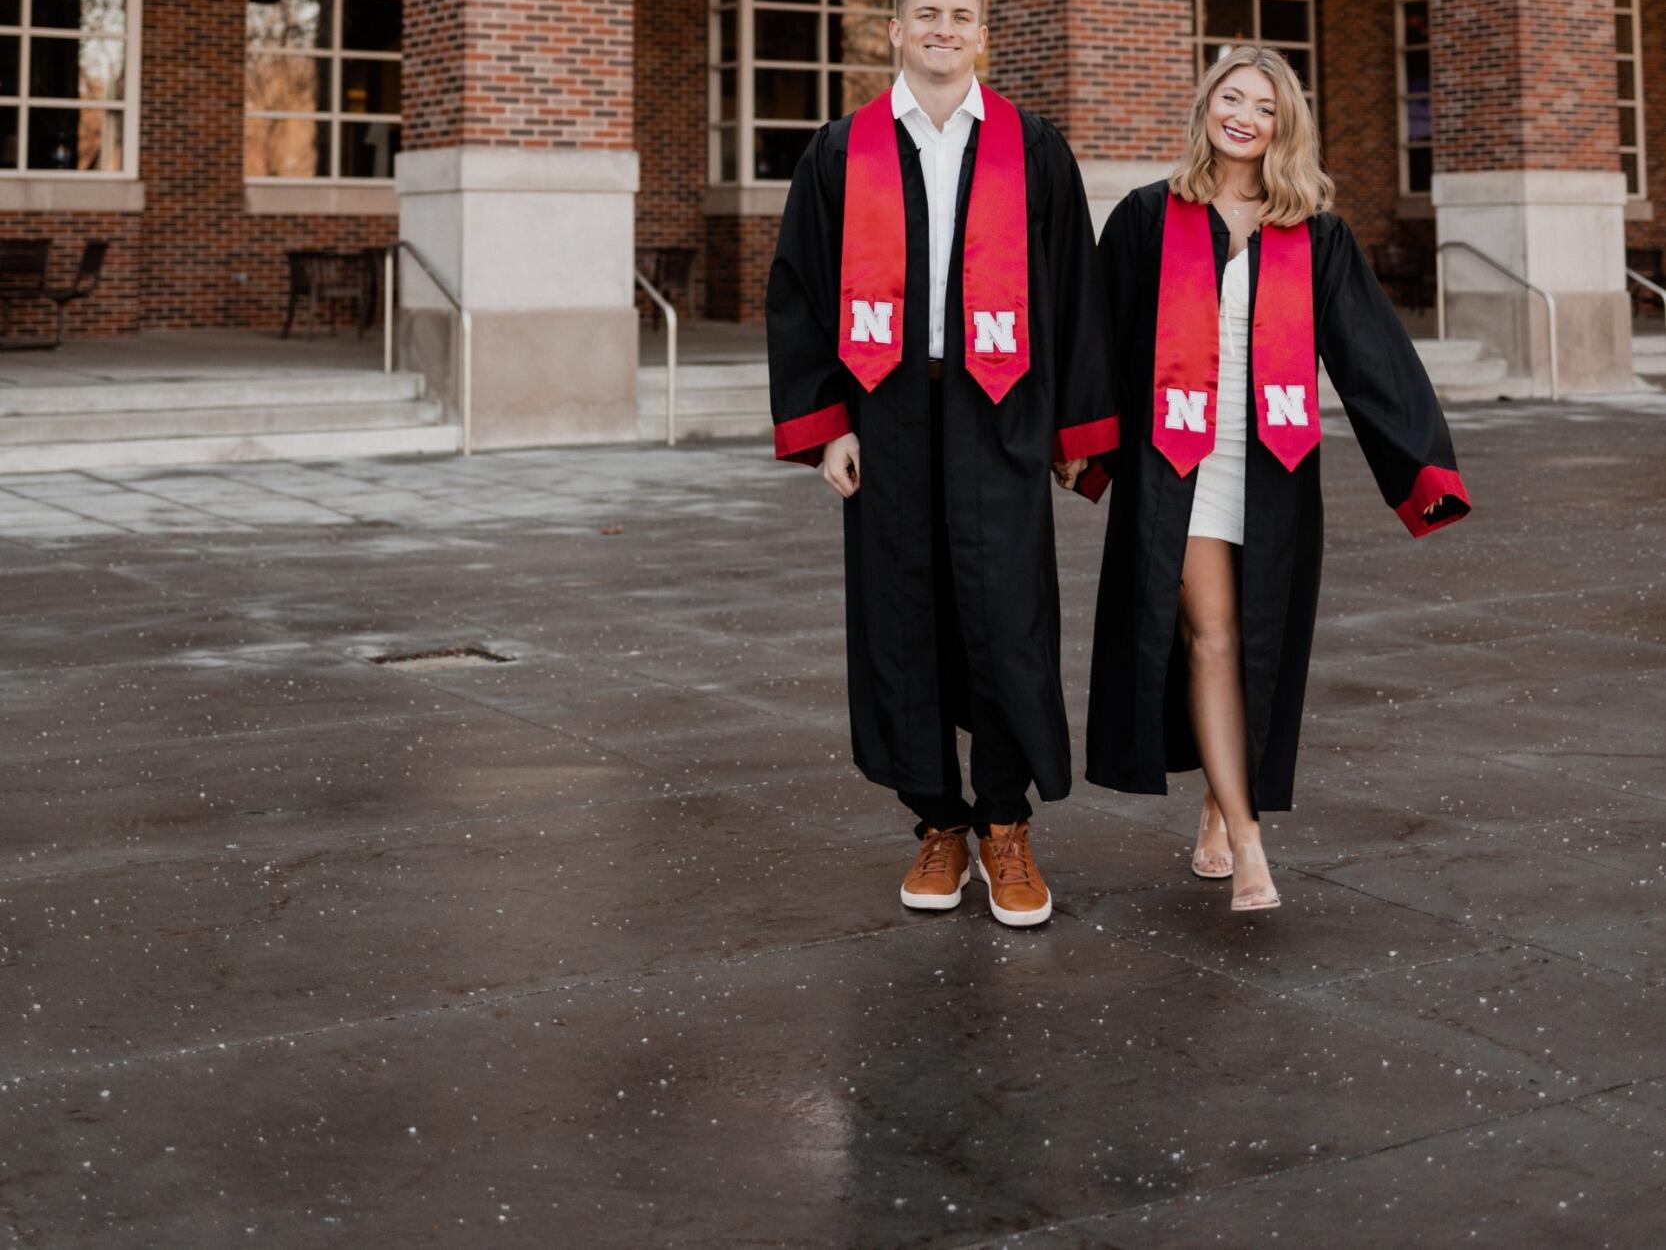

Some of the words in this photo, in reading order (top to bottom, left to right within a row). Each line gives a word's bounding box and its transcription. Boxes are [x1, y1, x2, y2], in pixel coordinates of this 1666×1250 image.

[851, 300, 893, 344] N
[973, 311, 1017, 353] N
[1164, 387, 1208, 434] N
[1264, 384, 1309, 426] N
